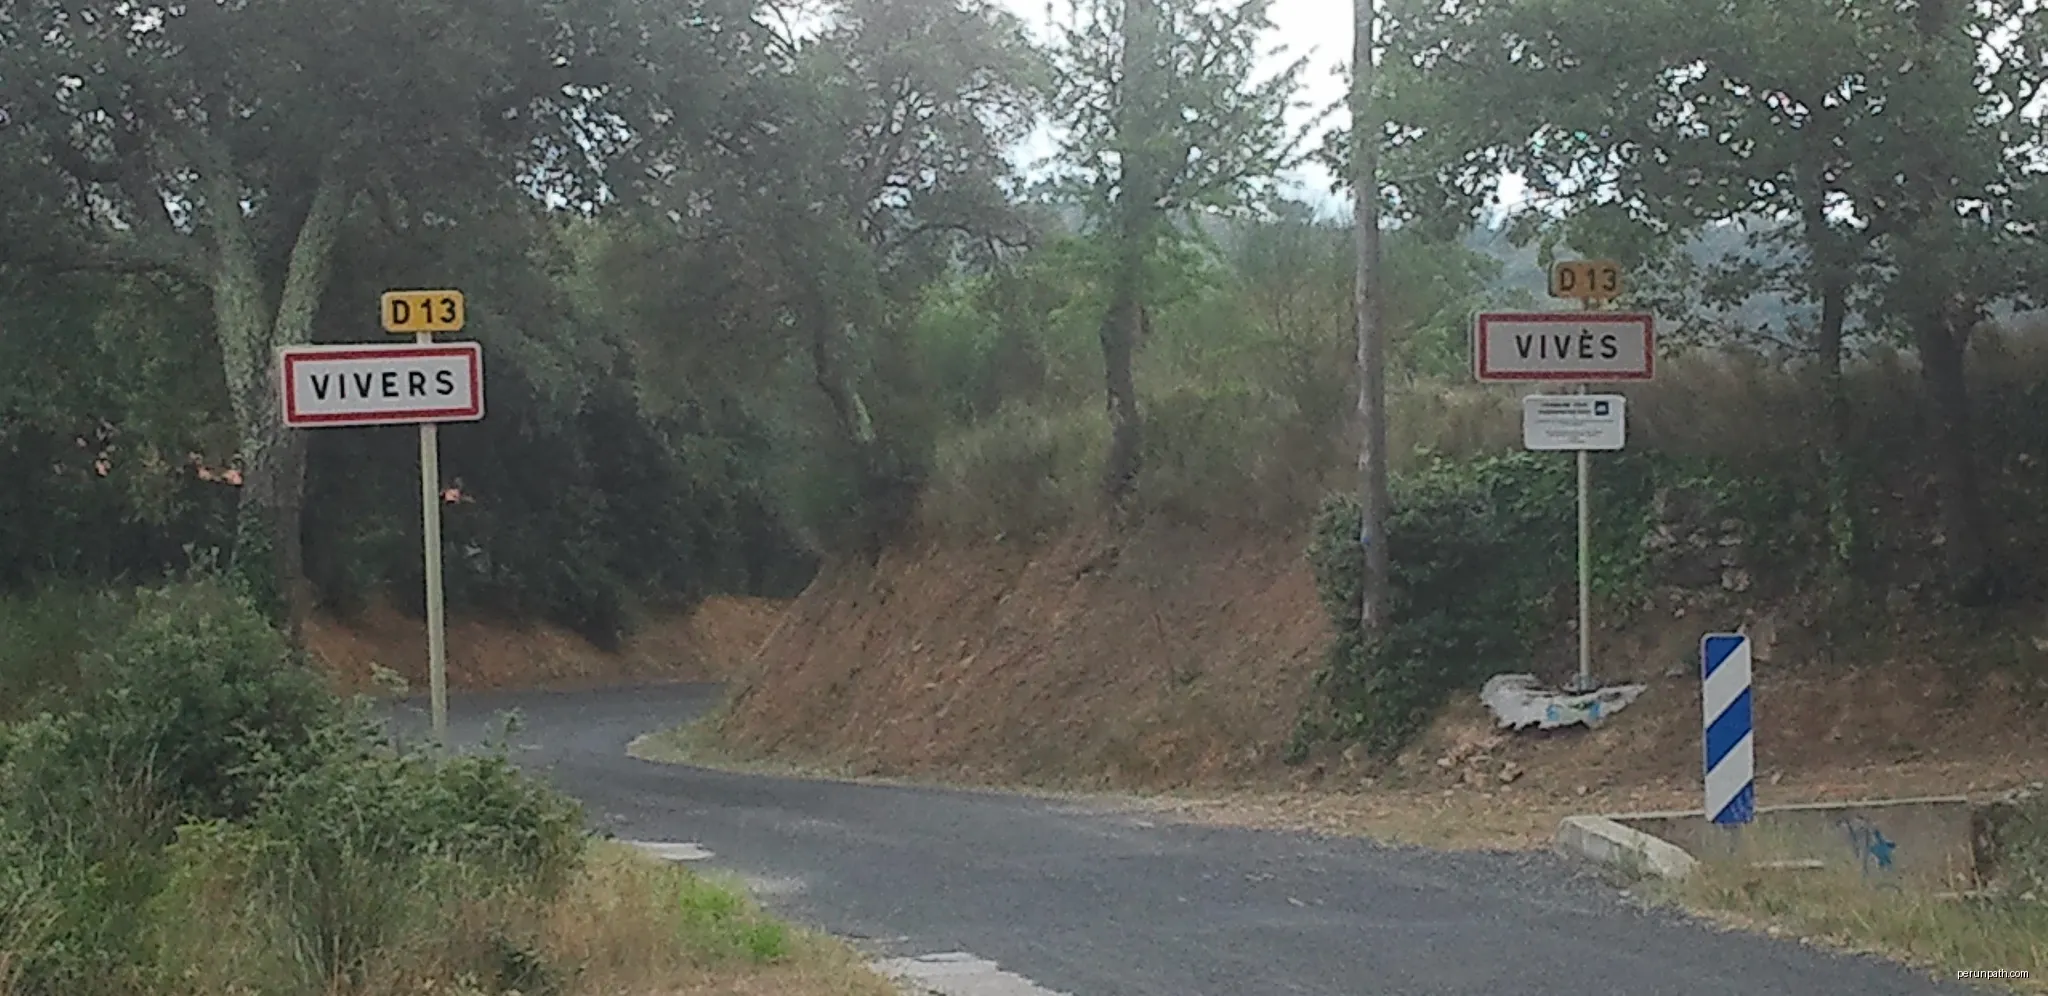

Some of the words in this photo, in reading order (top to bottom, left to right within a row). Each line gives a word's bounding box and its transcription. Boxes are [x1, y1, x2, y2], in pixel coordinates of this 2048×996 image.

[1559, 268, 1576, 291] D
[1586, 268, 1617, 291] 13
[392, 299, 410, 324] D
[420, 298, 456, 323] 13
[1515, 328, 1618, 359] VIVÈS
[310, 370, 455, 400] VIVERS
